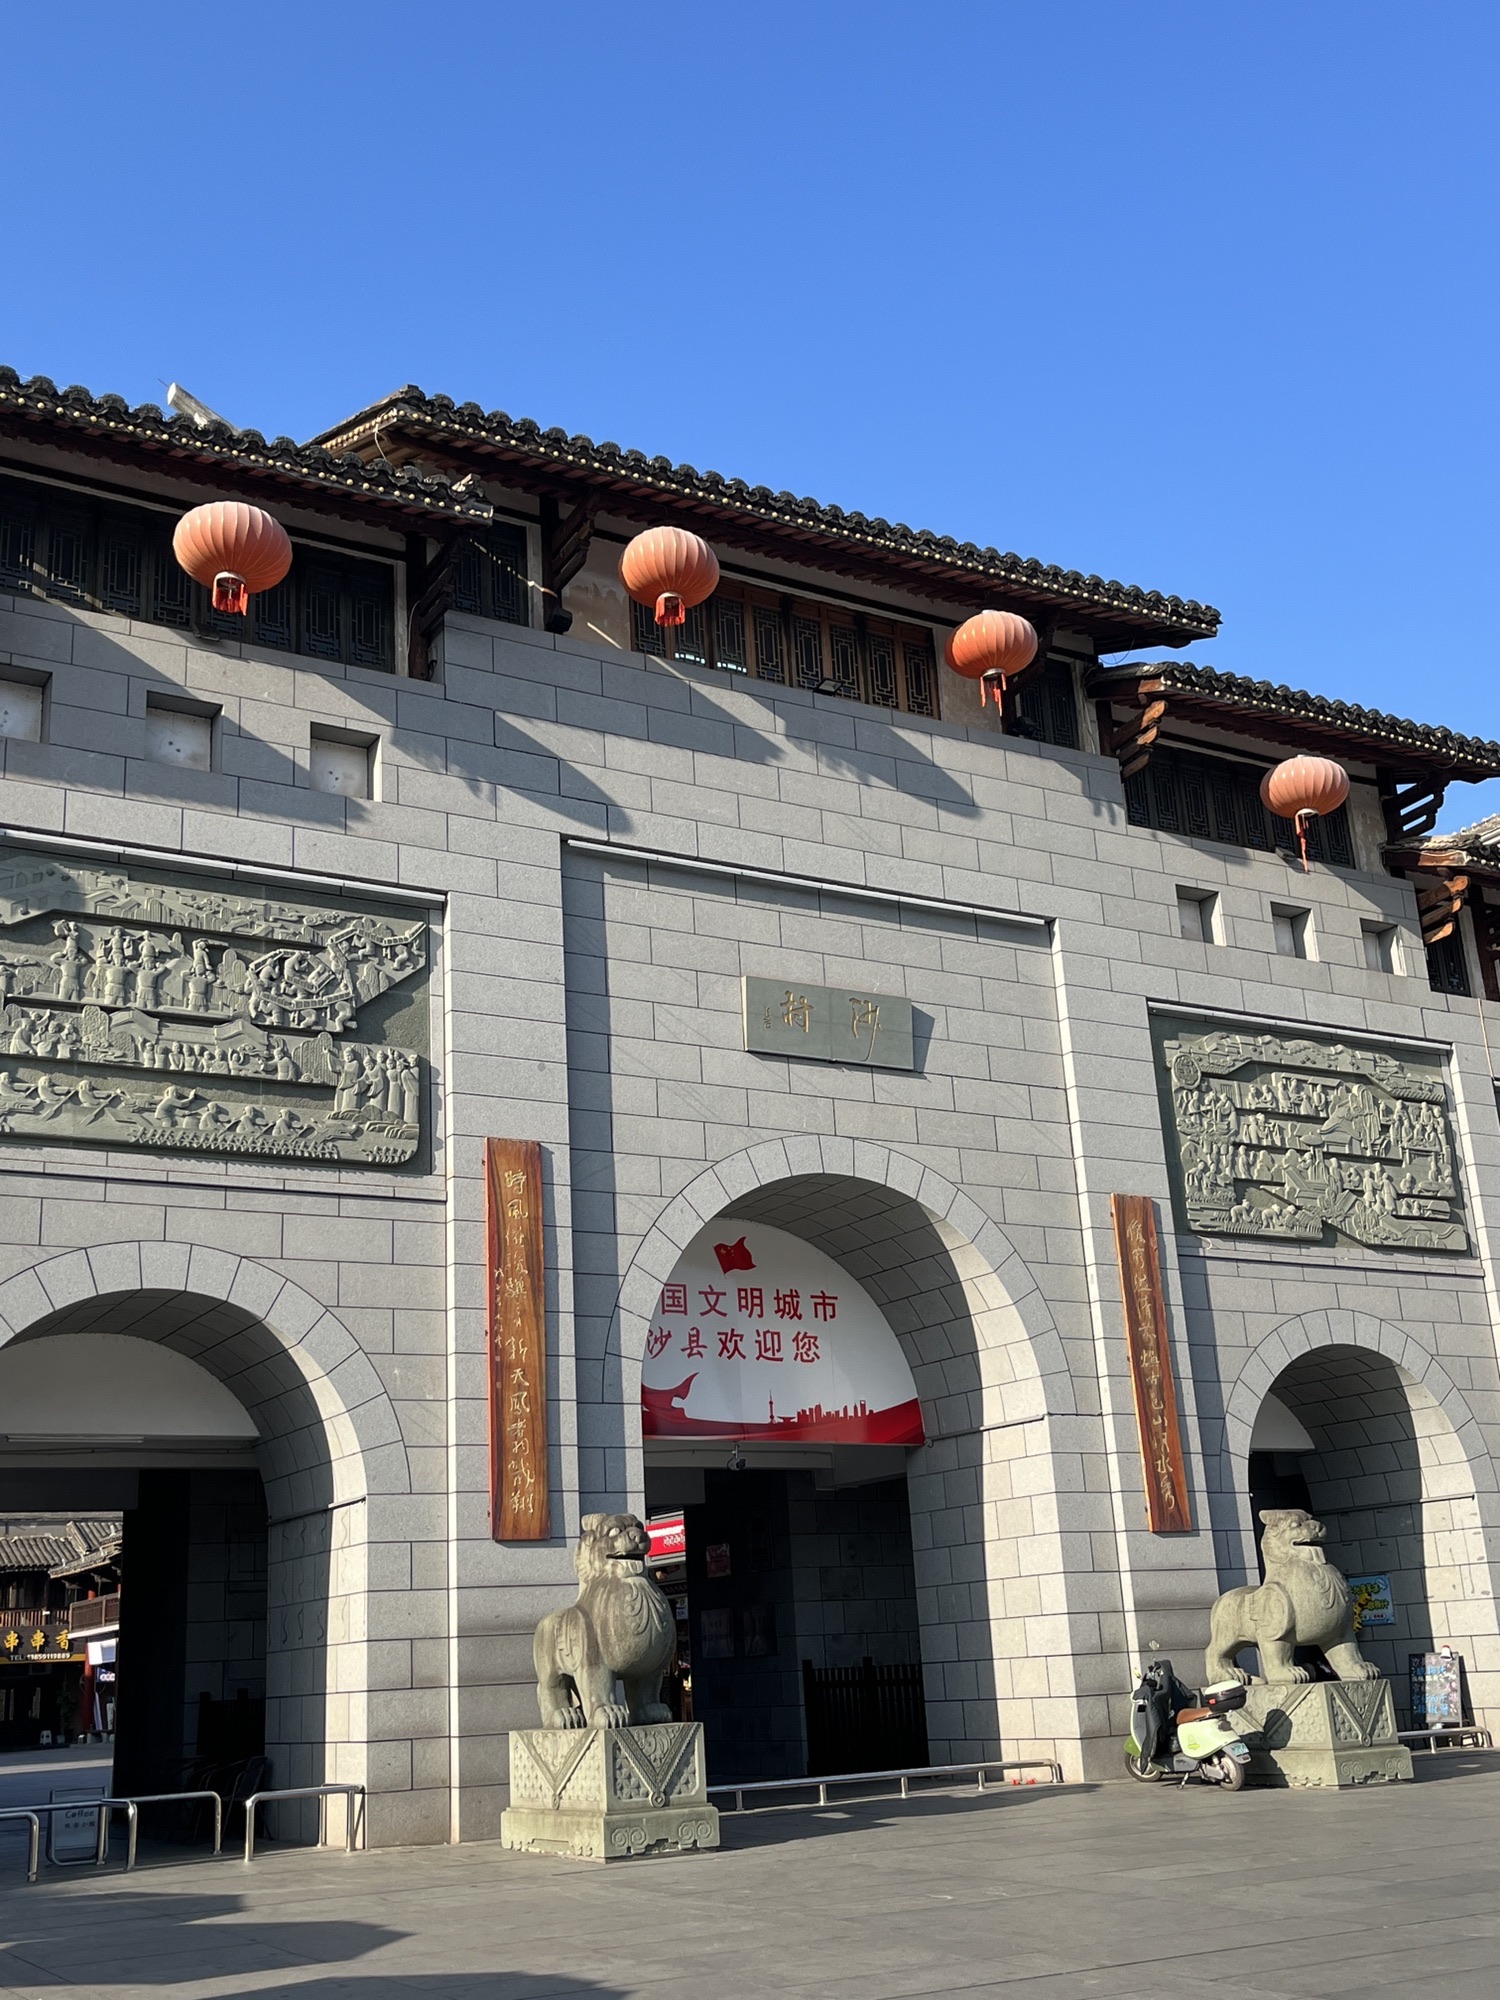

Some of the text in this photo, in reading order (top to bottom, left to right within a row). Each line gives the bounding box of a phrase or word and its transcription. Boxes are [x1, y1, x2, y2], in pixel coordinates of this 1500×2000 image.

[661, 1283, 838, 1322] 国文明城市
[647, 1326, 821, 1364] 沙县欢迎您
[3, 1629, 70, 1653] 串串香
